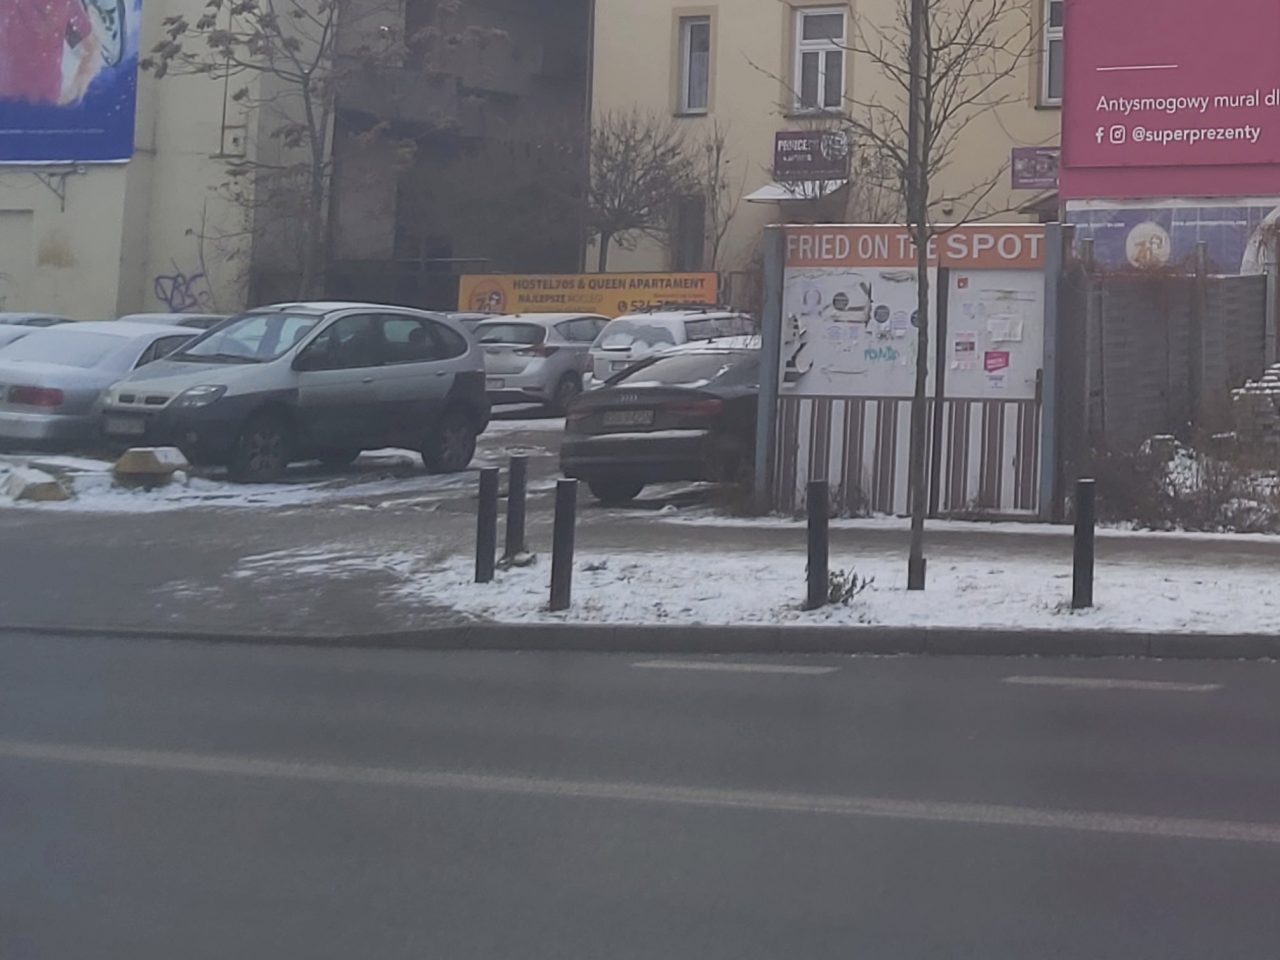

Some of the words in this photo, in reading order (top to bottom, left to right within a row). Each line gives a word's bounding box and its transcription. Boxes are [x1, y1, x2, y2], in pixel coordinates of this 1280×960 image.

[1096, 94, 1210, 115] Antysmogowy
[1214, 90, 1259, 108] mural
[1132, 124, 1261, 145] @superprezenty
[787, 234, 850, 259] FRIED
[858, 234, 889, 259] ON
[945, 233, 1045, 259] SPOT
[588, 278, 626, 290] QUEEN
[629, 277, 705, 289] APARTAMENT
